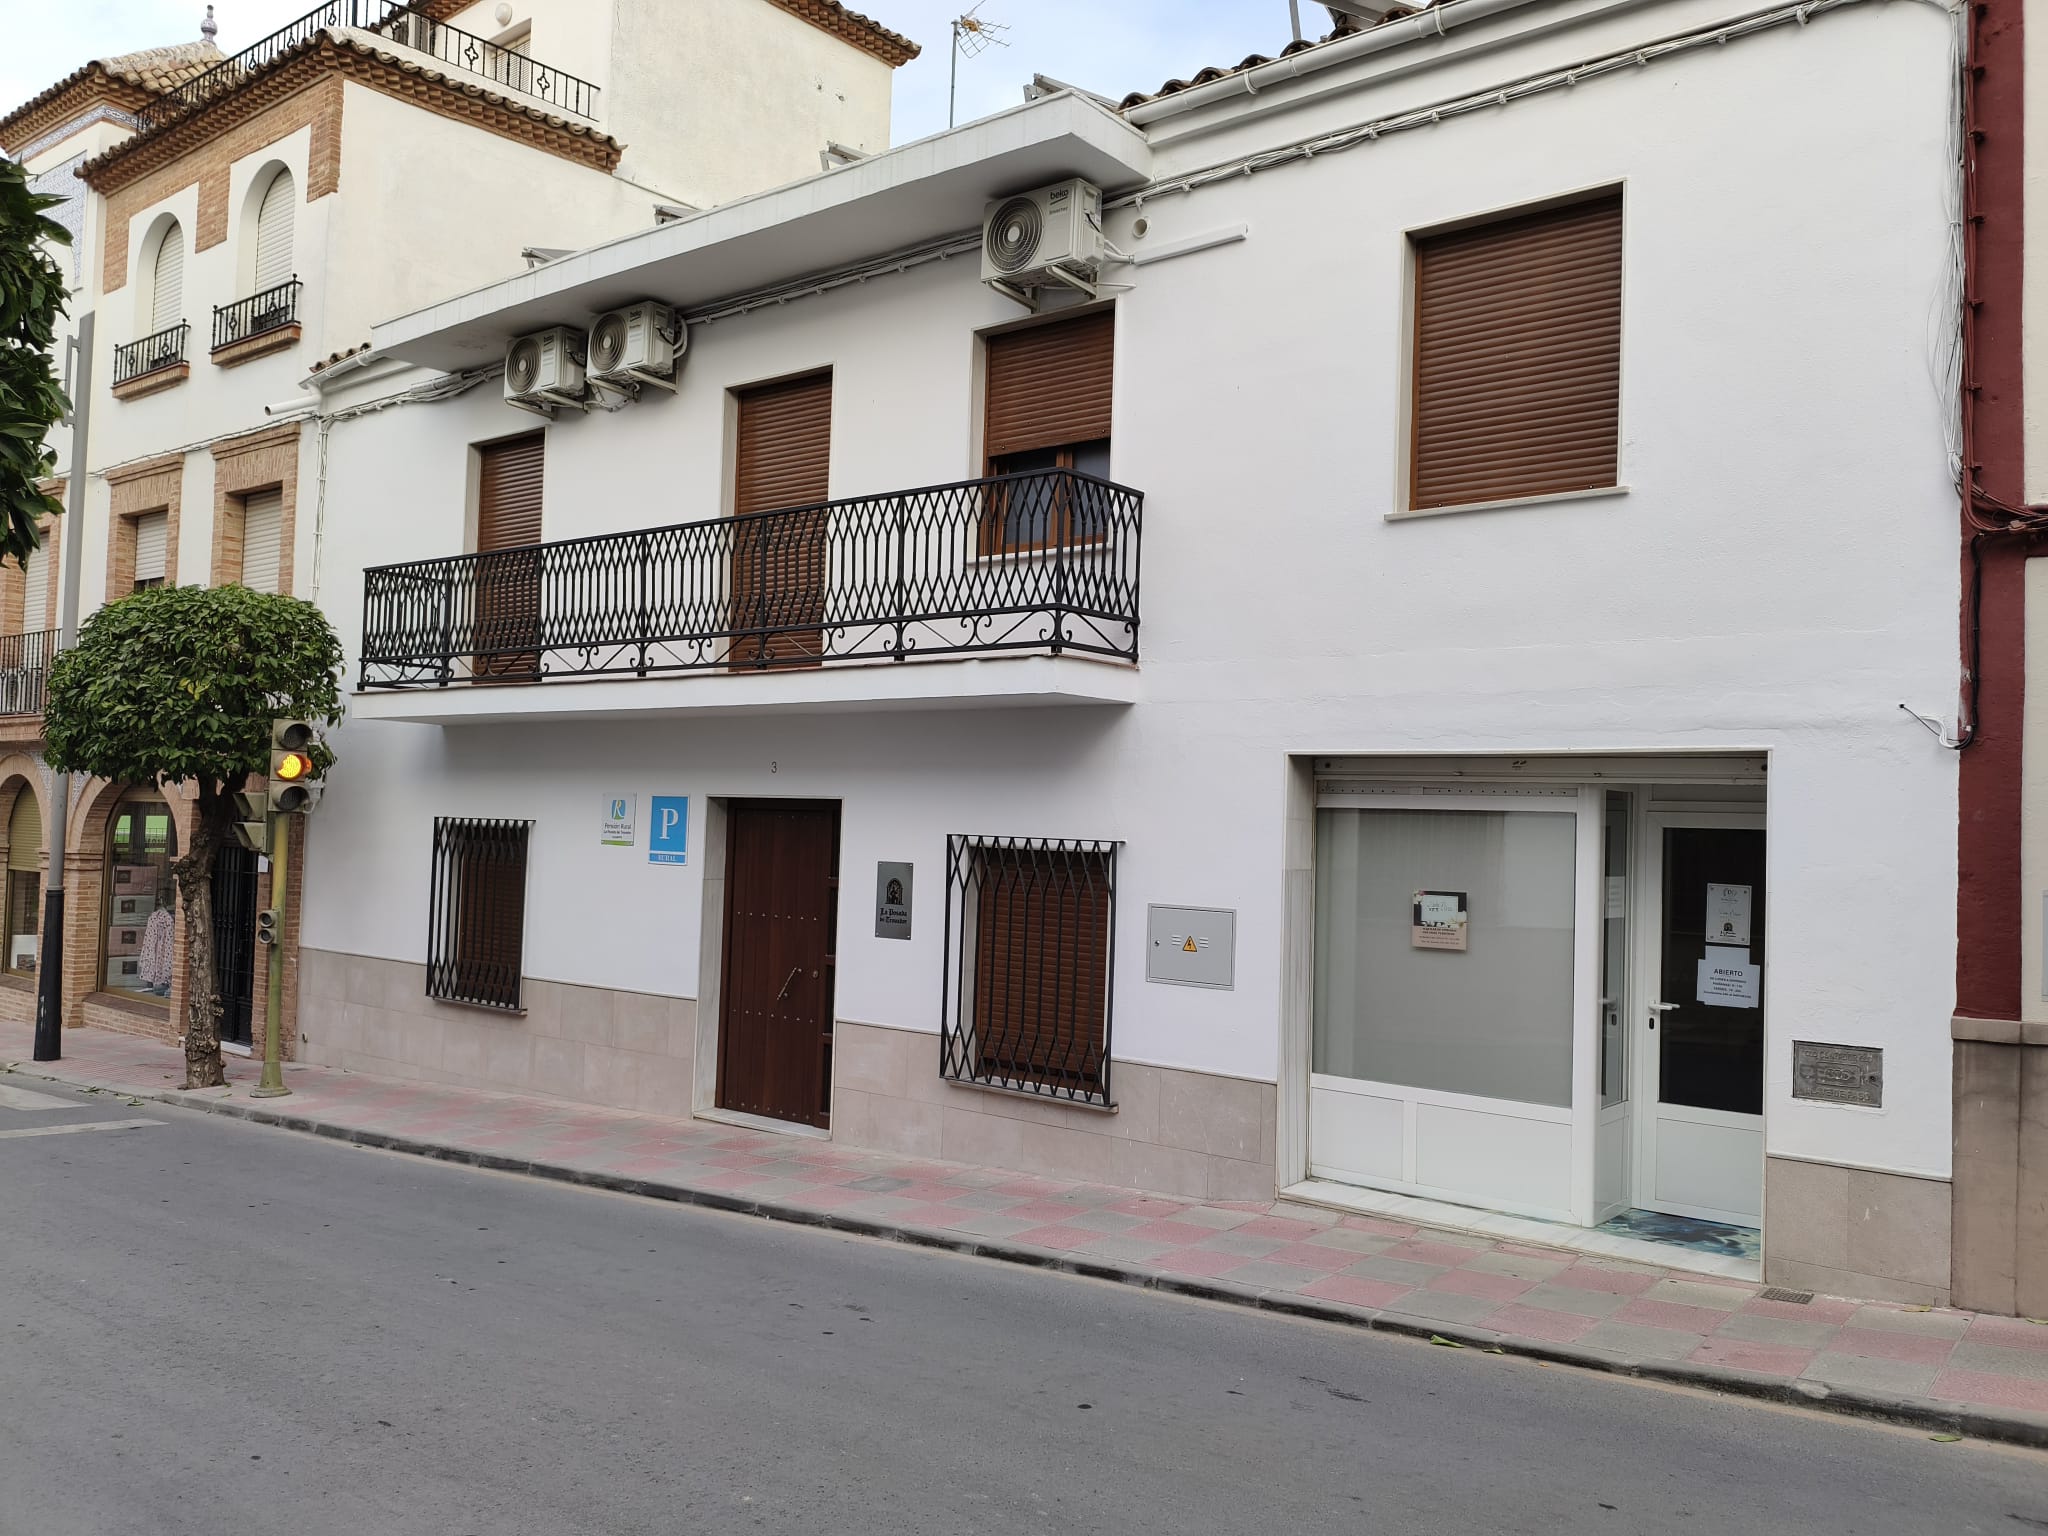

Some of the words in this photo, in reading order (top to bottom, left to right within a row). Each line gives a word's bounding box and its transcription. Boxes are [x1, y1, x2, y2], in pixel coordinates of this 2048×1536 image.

[1050, 189, 1069, 200] beko
[771, 760, 778, 774] 3
[659, 808, 679, 840] P
[1713, 968, 1744, 977] ABIERTO
